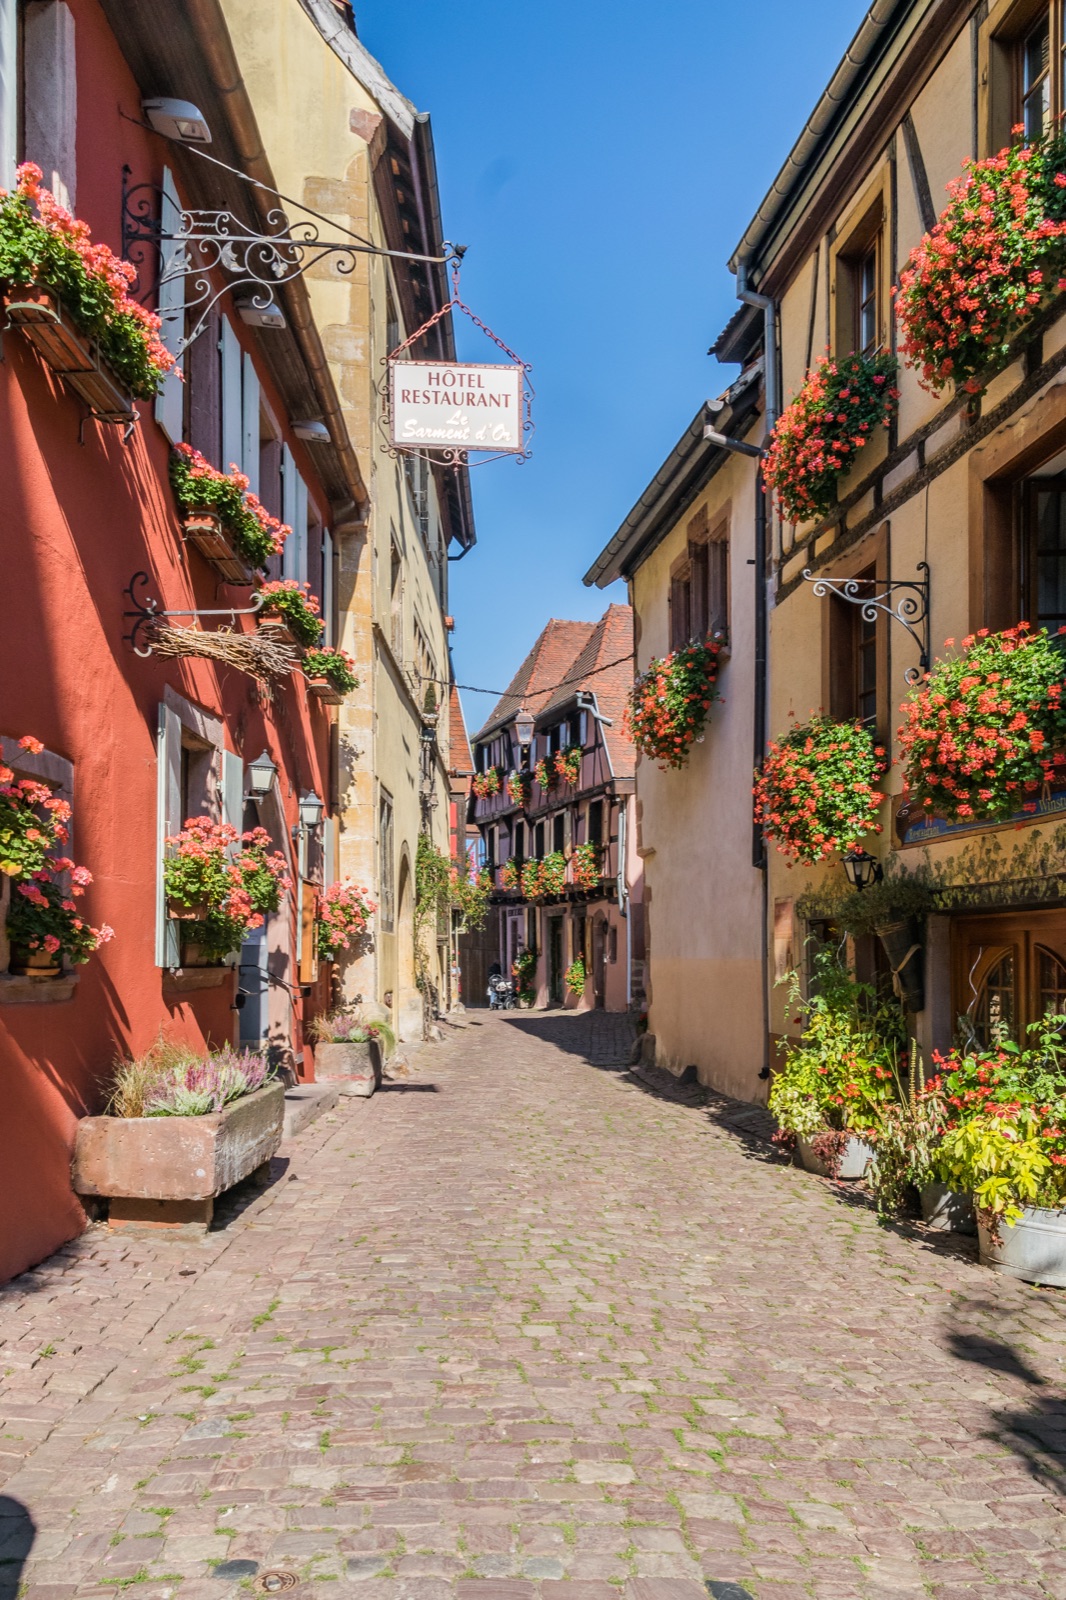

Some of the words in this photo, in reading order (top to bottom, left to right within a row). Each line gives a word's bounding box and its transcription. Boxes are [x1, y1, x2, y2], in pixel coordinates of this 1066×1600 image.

[428, 369, 485, 389] HÔTEL
[401, 389, 512, 408] RESTAURANT
[446, 409, 468, 425] Le
[402, 418, 470, 440] Sarment
[475, 423, 512, 442] d'Or
